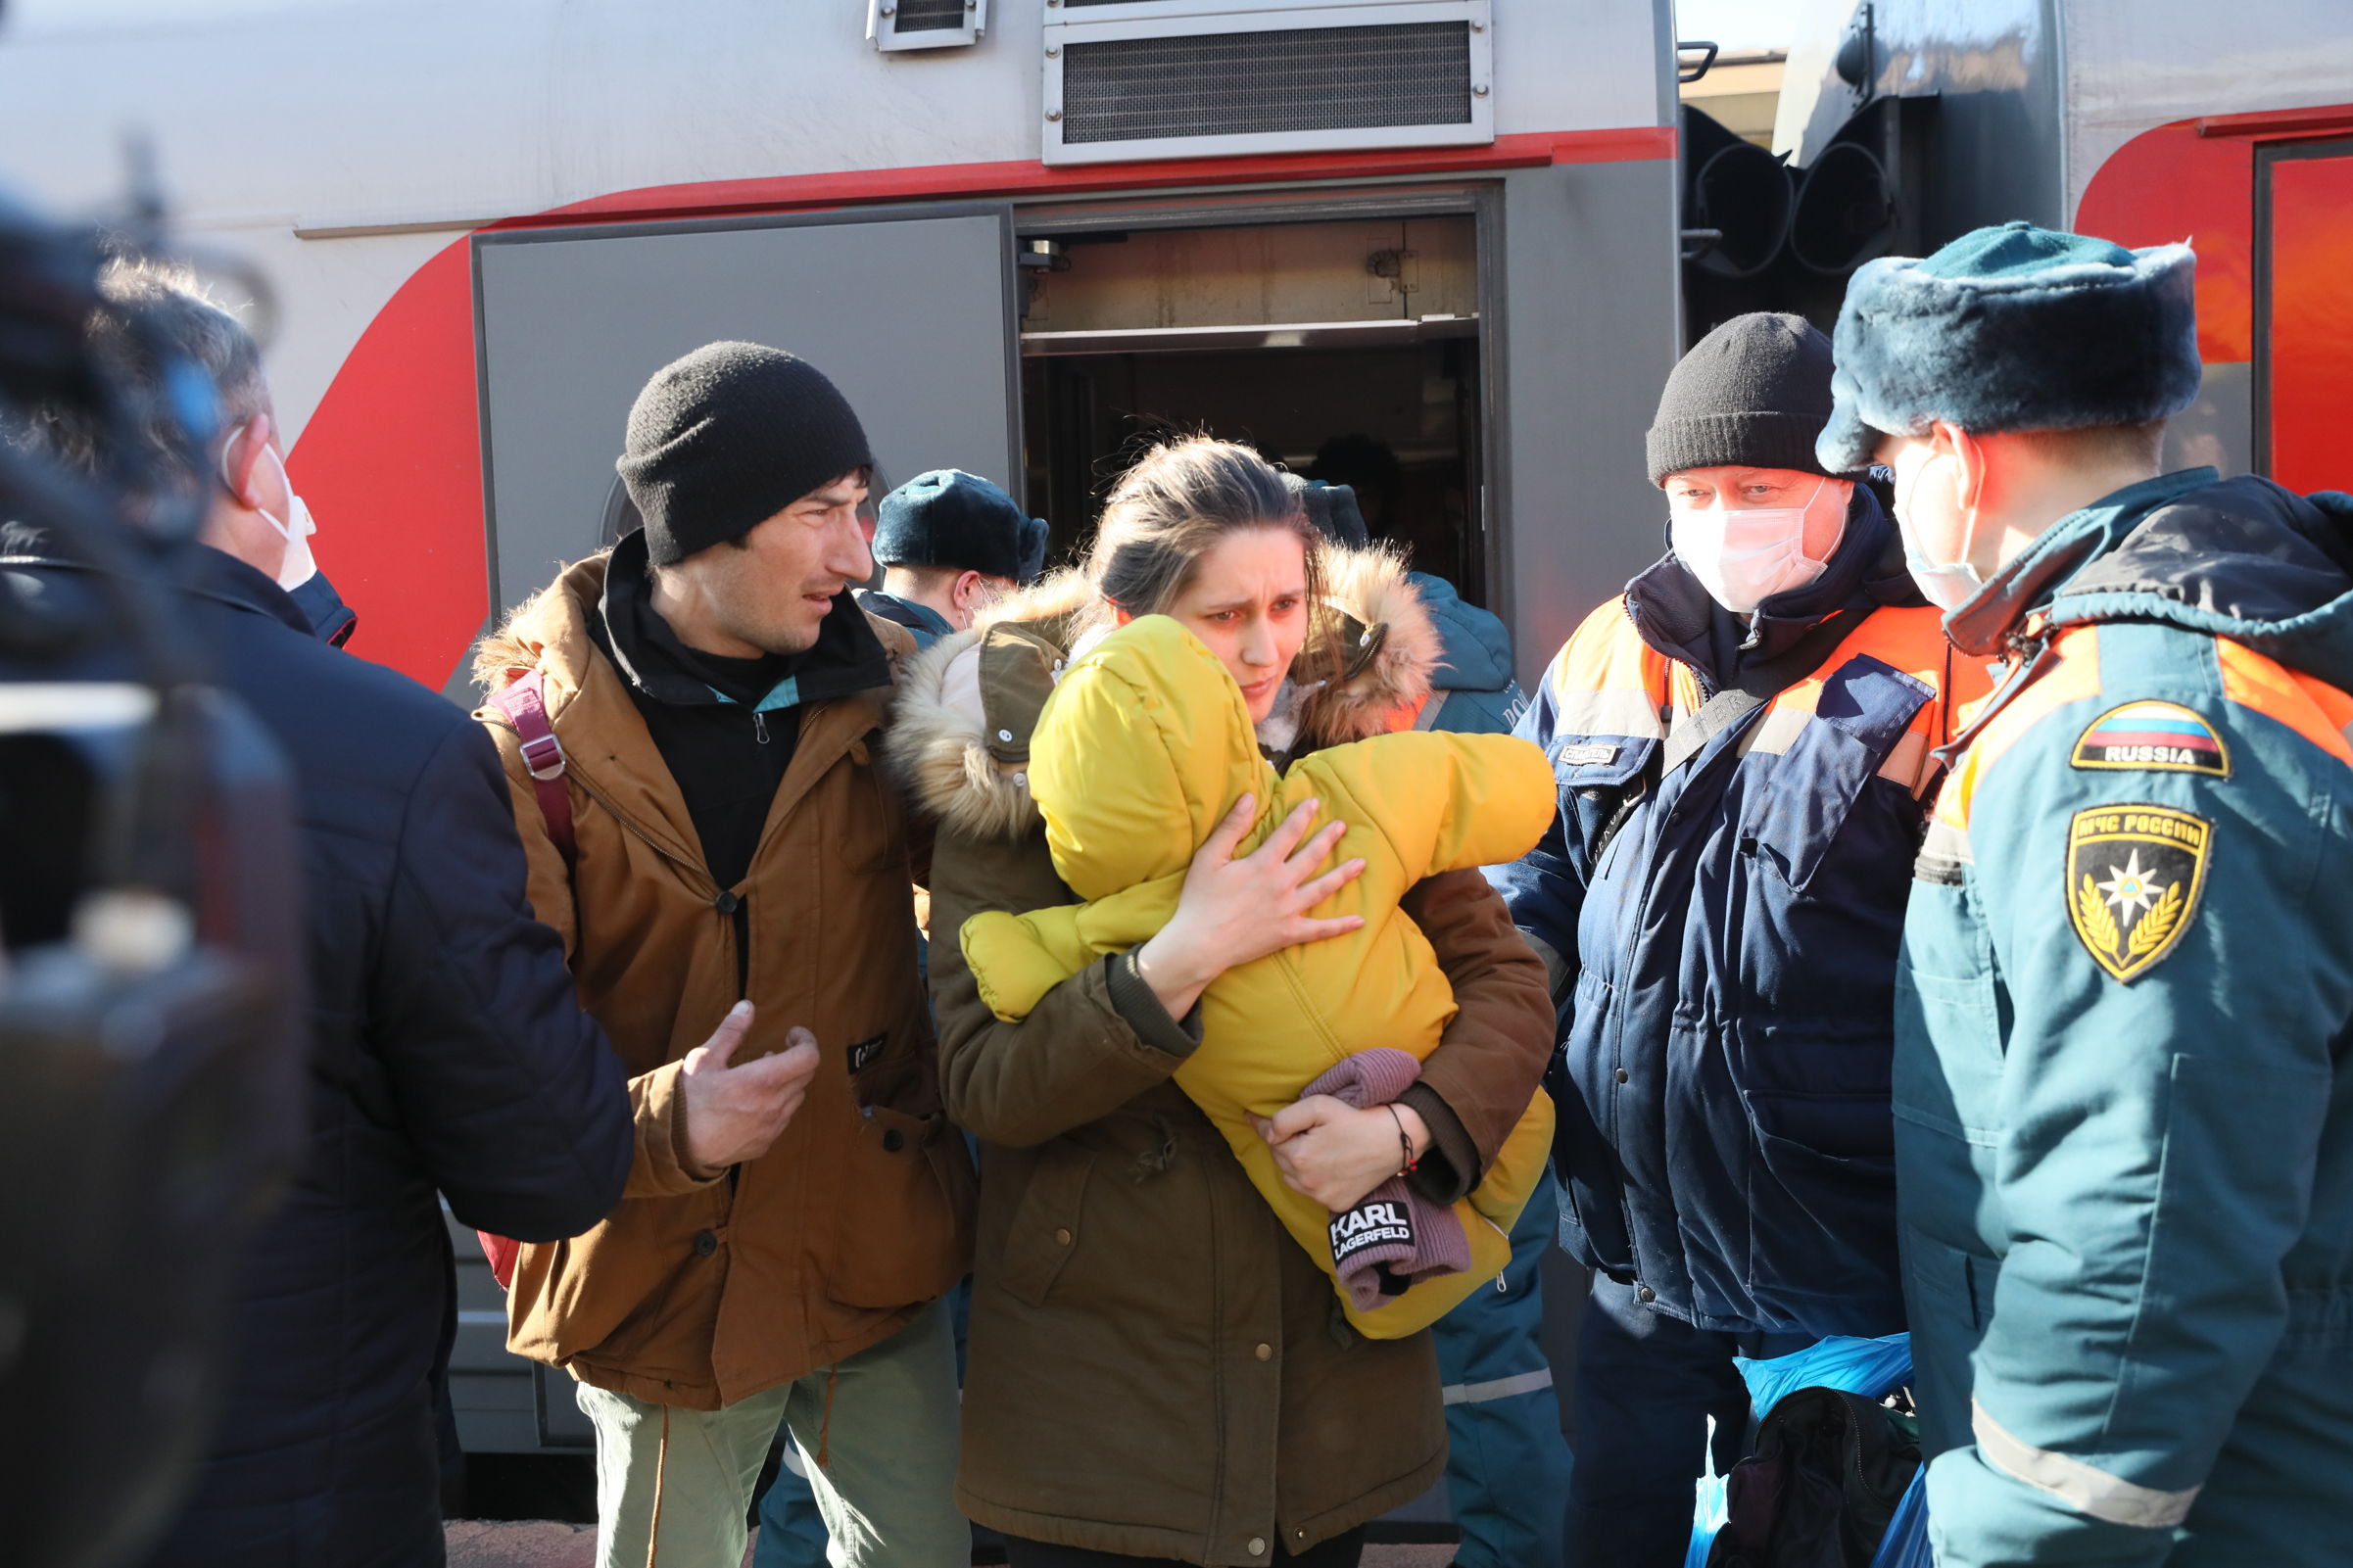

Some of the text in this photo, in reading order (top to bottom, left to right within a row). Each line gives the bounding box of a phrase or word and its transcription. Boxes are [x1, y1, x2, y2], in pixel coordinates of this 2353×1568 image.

[2104, 745, 2195, 765] RUSSIA
[2077, 815, 2201, 846] МЧС РОССИИ
[1330, 1203, 1408, 1247] KARL
[1334, 1226, 1411, 1261] LAGERFELD
